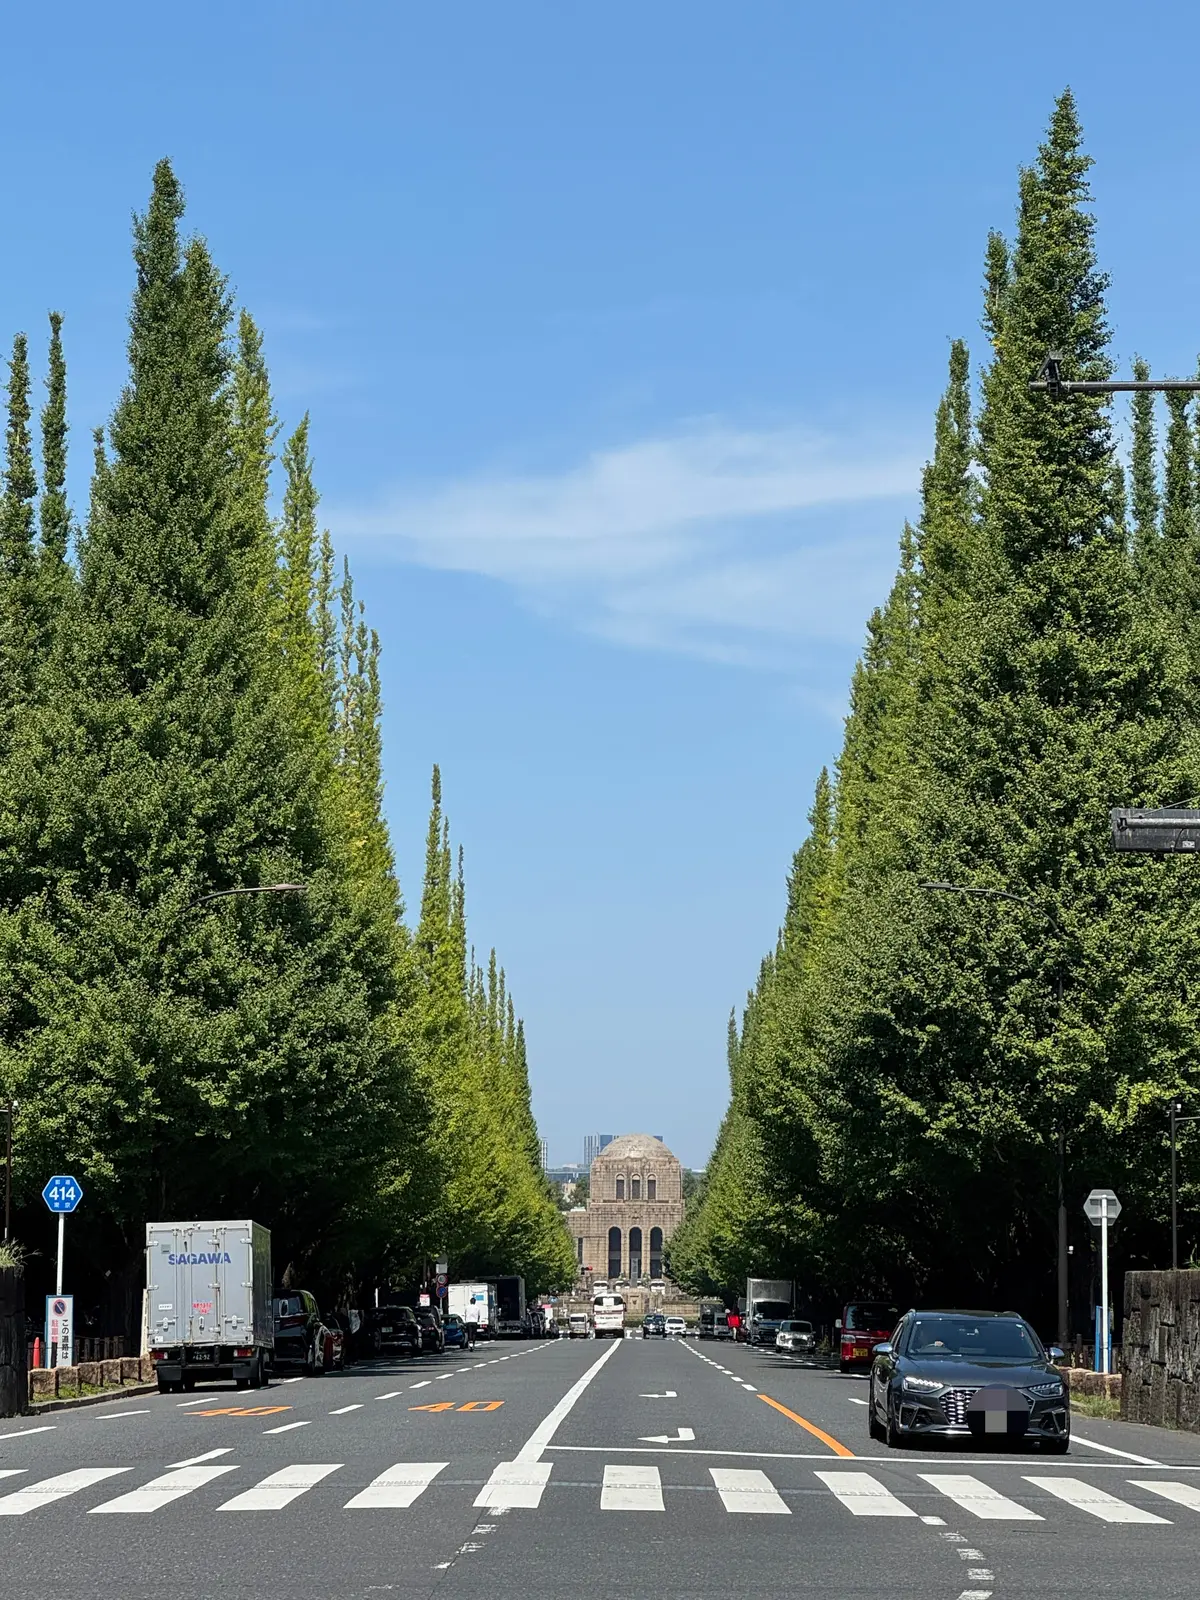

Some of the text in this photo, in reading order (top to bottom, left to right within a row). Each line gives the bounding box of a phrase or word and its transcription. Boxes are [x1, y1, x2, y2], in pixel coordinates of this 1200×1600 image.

[49, 1186, 76, 1201] 414
[168, 1252, 231, 1265] SAGAWA
[61, 1319, 70, 1360] この道路は
[407, 1401, 505, 1412] 40
